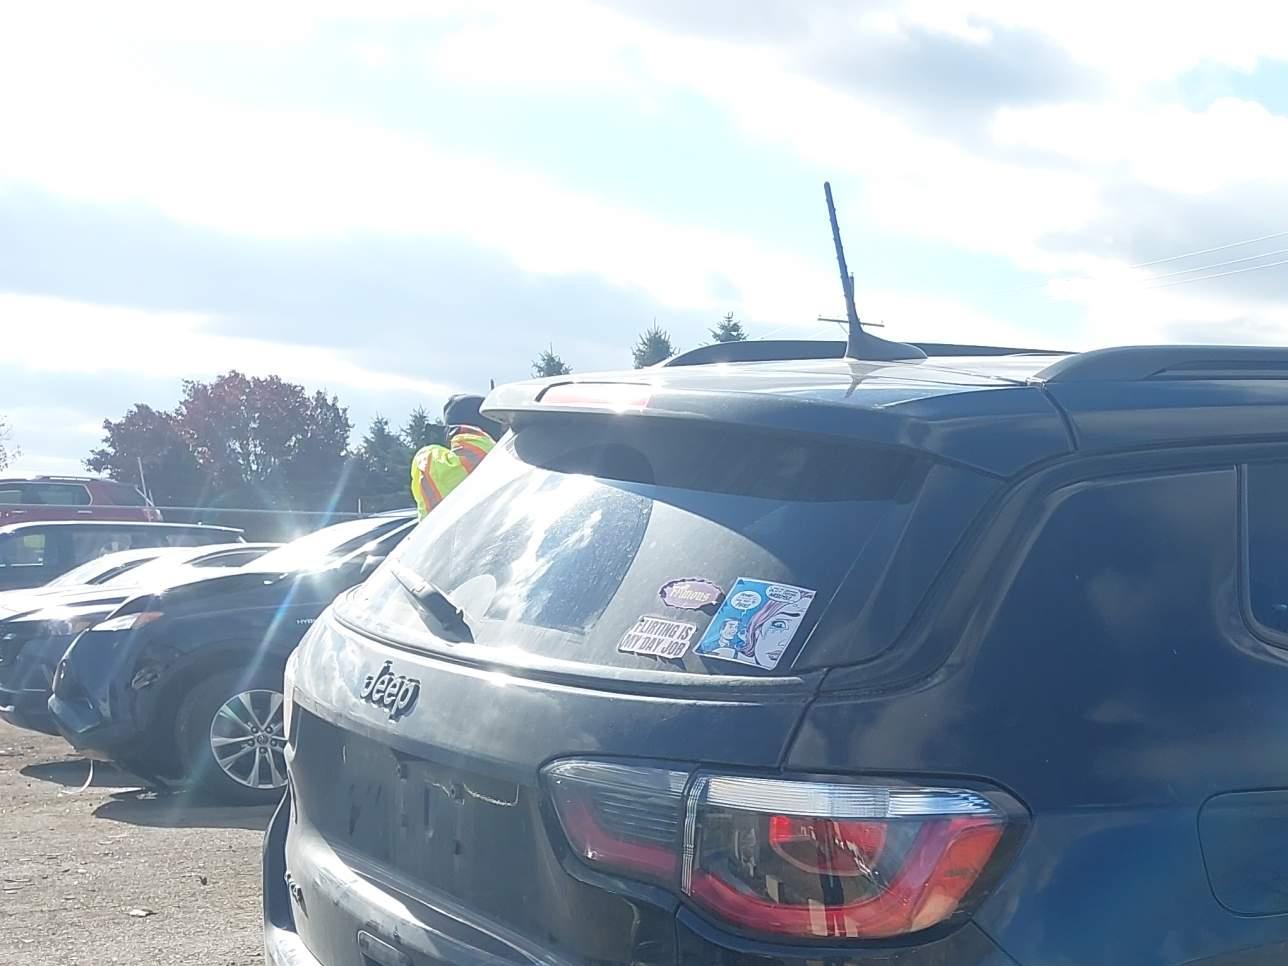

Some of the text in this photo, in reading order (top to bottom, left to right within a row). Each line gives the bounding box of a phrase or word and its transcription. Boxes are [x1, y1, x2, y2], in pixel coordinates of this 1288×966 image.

[633, 619, 693, 641] FLIRTING IS
[619, 633, 687, 657] MY DAY JOB
[360, 660, 420, 722] Jeep
